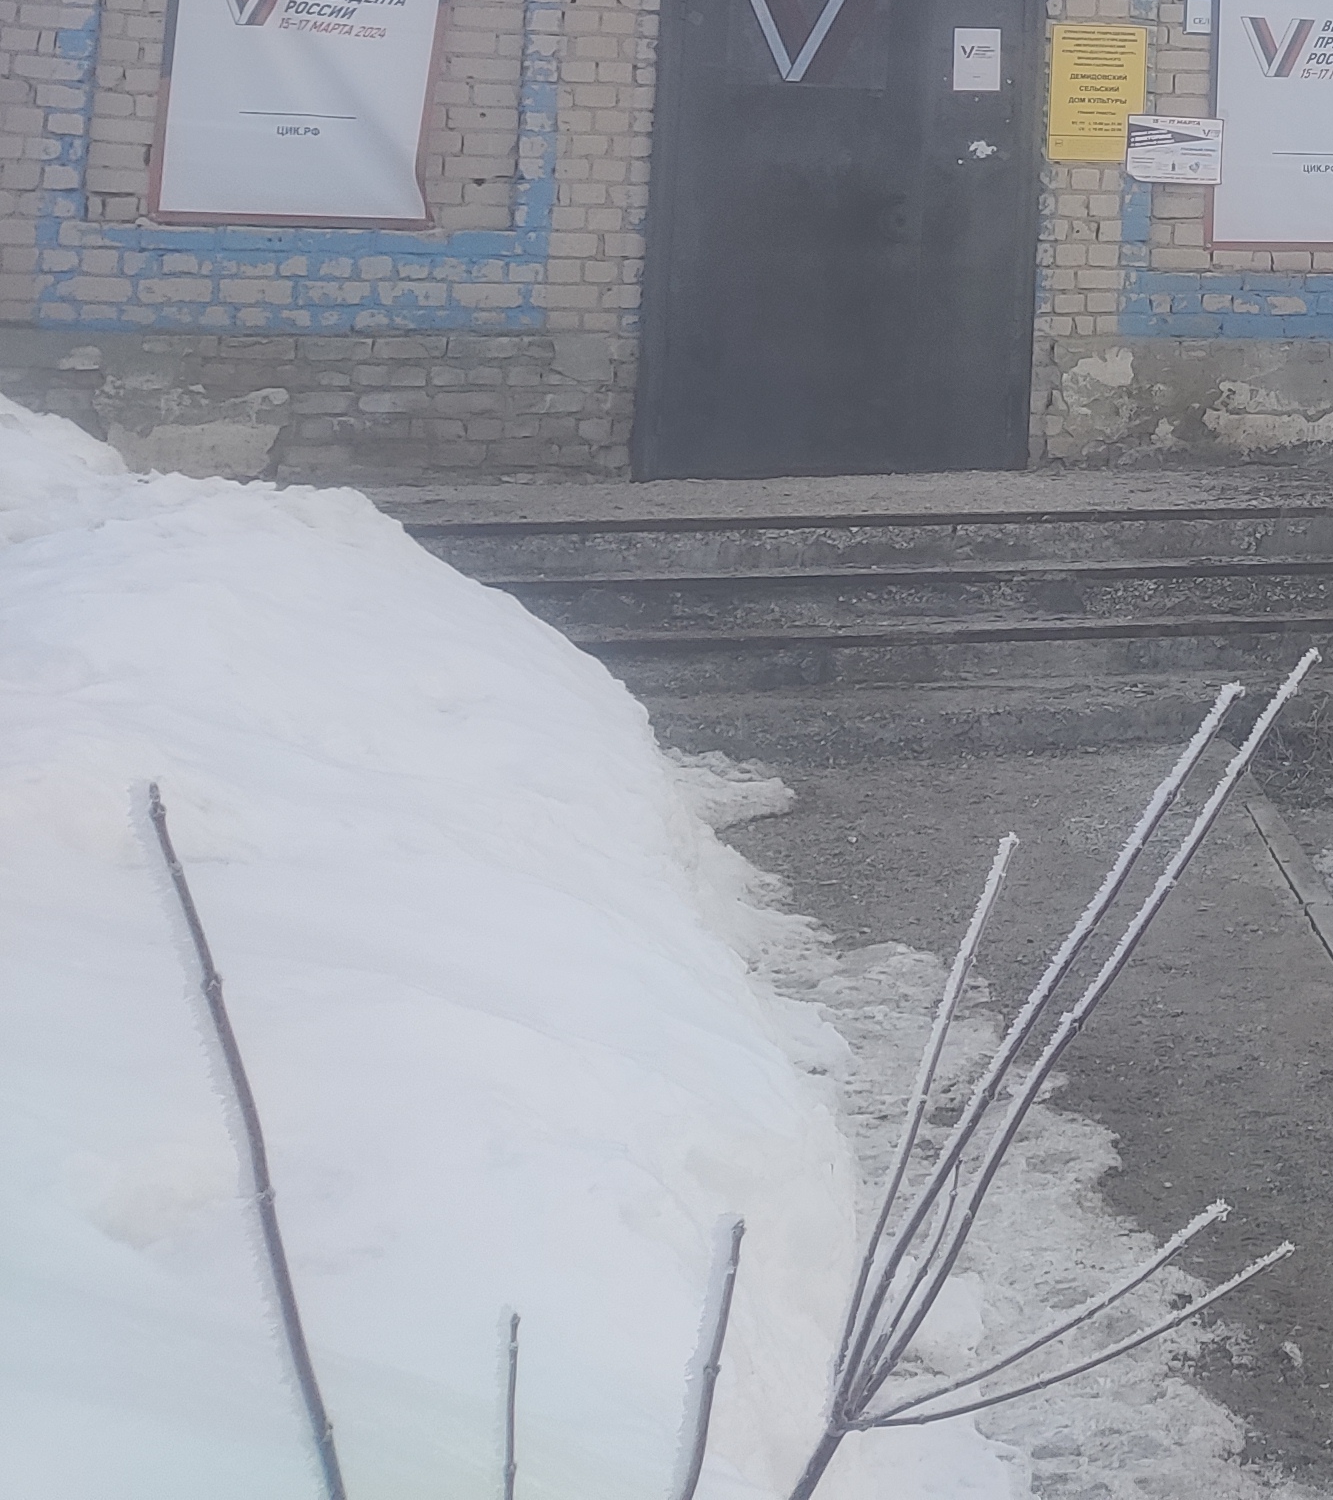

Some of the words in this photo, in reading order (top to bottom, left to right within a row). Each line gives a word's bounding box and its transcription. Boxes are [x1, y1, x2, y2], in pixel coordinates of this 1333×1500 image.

[284, 0, 358, 20] РОССИИ
[309, 20, 354, 36] МАРТА
[354, 26, 387, 39] 2024
[276, 125, 320, 136] ЦИК.РФ
